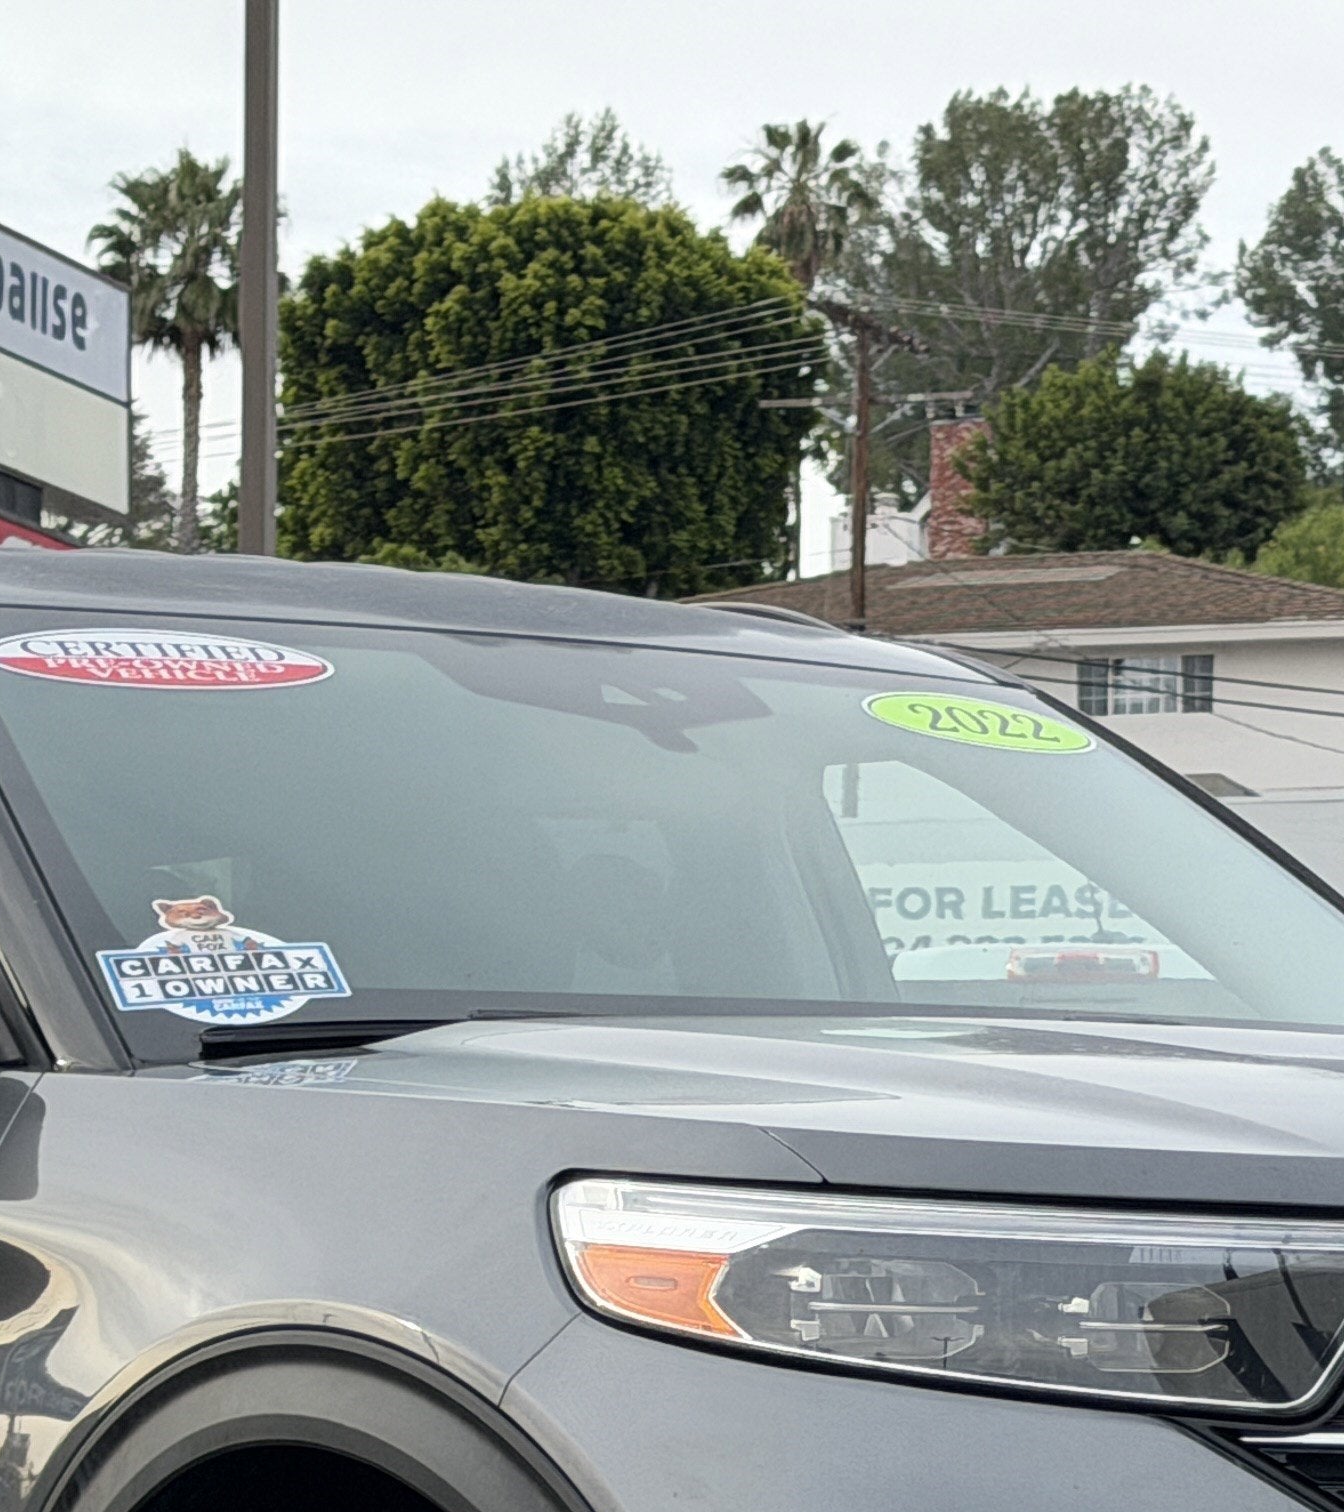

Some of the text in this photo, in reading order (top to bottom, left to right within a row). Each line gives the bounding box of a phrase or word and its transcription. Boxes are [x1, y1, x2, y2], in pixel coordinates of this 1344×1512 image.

[20, 640, 286, 663] CERTIFIED
[45, 657, 285, 675] PRE-OWNED
[86, 668, 261, 682] VEHICLE
[907, 702, 1061, 743] 2022
[868, 886, 965, 921] FOR
[120, 953, 321, 976] CARFAX
[131, 973, 330, 998] 1 OWNER
